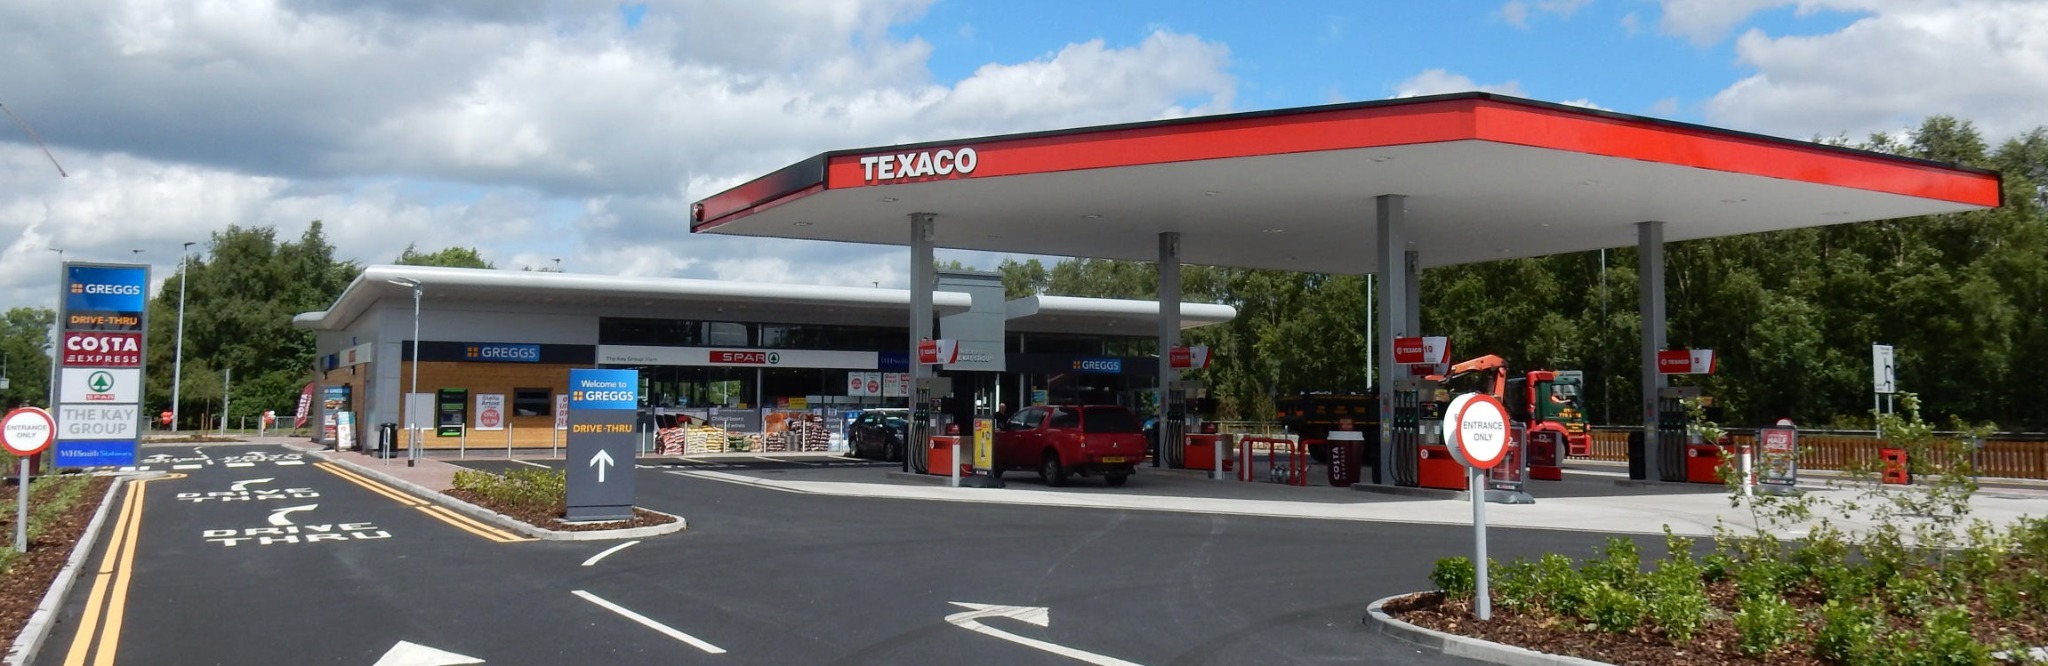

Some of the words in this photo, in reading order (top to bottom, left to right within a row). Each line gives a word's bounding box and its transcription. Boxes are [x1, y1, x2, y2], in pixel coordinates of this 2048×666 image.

[860, 147, 977, 181] TEXACO
[85, 283, 140, 295] GREGGS
[71, 315, 138, 326] DRIVE-THRU
[67, 335, 138, 353] COSTA
[482, 346, 536, 359] GREGGS
[722, 352, 766, 363] SPAR
[77, 355, 138, 363] EXPRESS
[1082, 360, 1119, 370] GREGGS
[581, 380, 617, 388] Welcome
[585, 391, 634, 401] GREGGS
[64, 408, 96, 421] THE
[101, 408, 135, 421] KAY
[69, 422, 128, 435] GROUP
[573, 424, 632, 433] DRIVE-THRU
[1463, 421, 1503, 430] ENTRANCE
[1473, 432, 1493, 441] ONLY
[60, 449, 99, 458] WHSmith
[1332, 446, 1341, 480] COSTA
[203, 521, 379, 537] DRIVE
[206, 530, 392, 546] THRU
